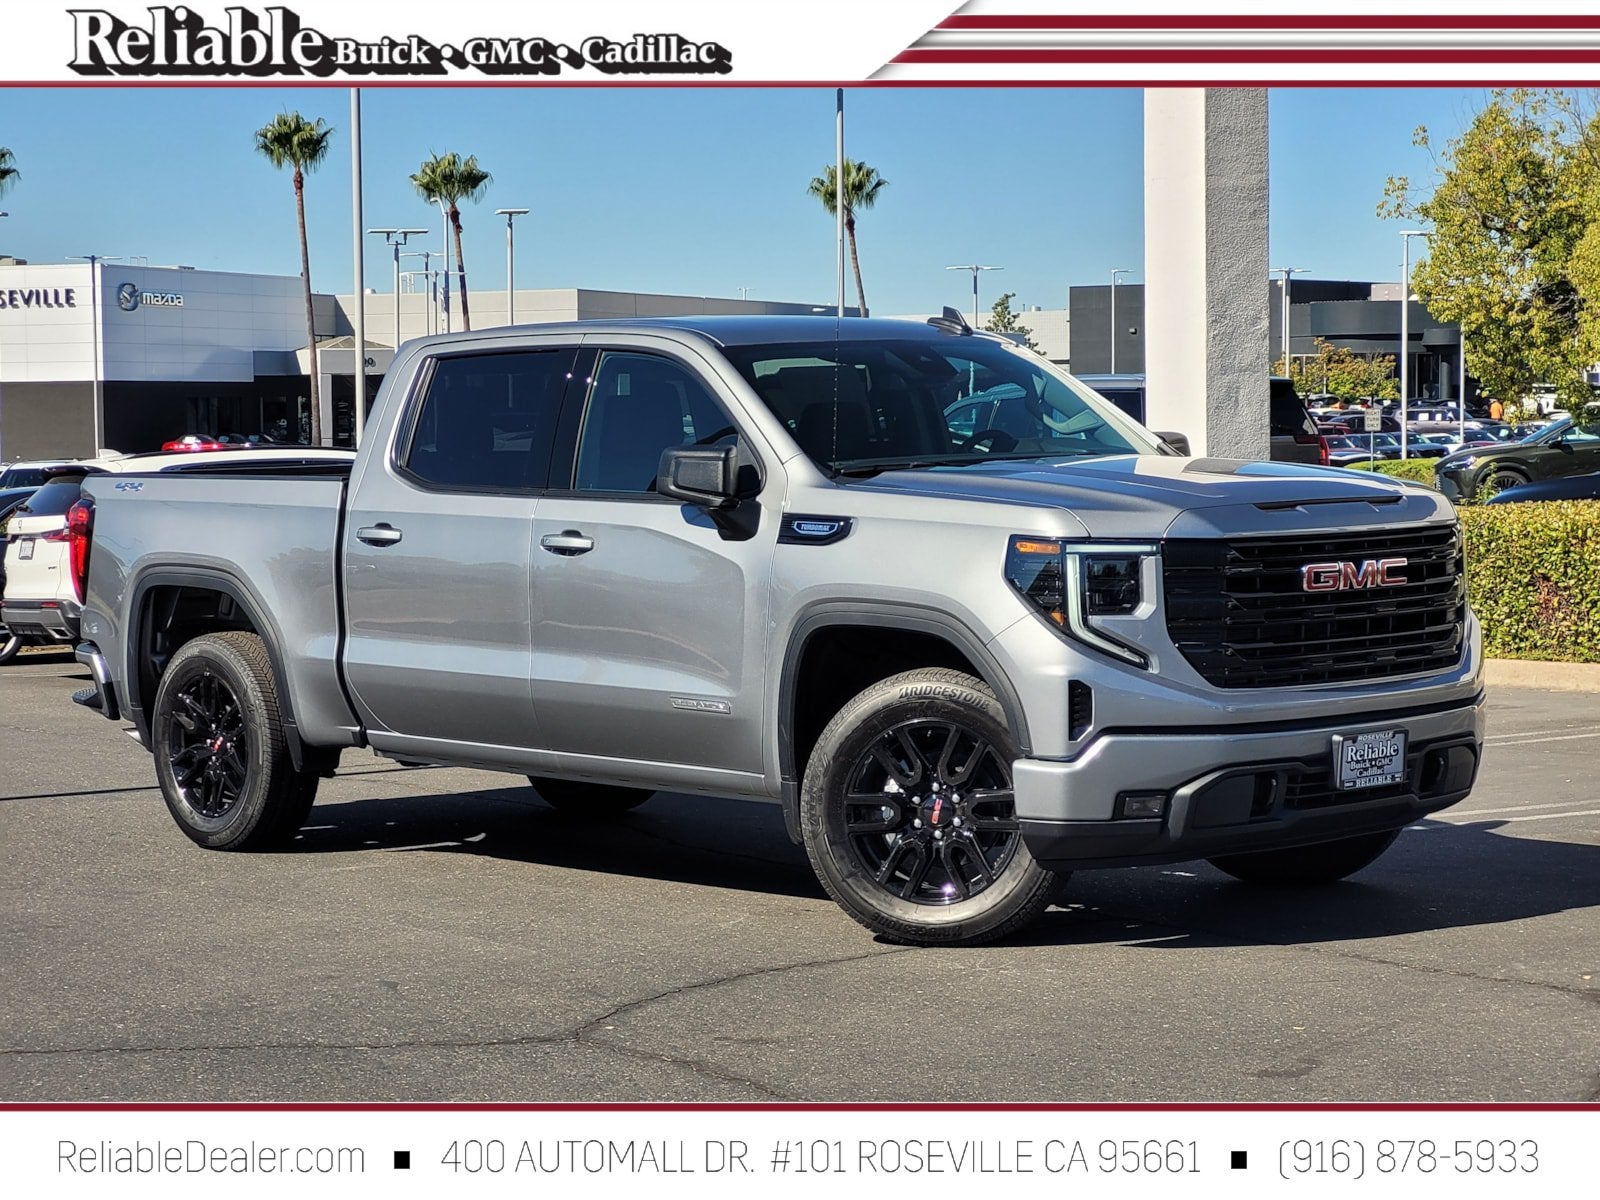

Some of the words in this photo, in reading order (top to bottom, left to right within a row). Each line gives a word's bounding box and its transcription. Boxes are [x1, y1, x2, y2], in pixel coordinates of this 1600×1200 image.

[1303, 558, 1408, 592] GMC
[1358, 731, 1393, 741] ROSEVILLE
[1347, 740, 1399, 763] Reliable
[1350, 760, 1371, 770] Buick
[1376, 757, 1393, 767] GMC
[1357, 767, 1384, 777] Cadillac
[1356, 775, 1393, 788] RELIABLE
